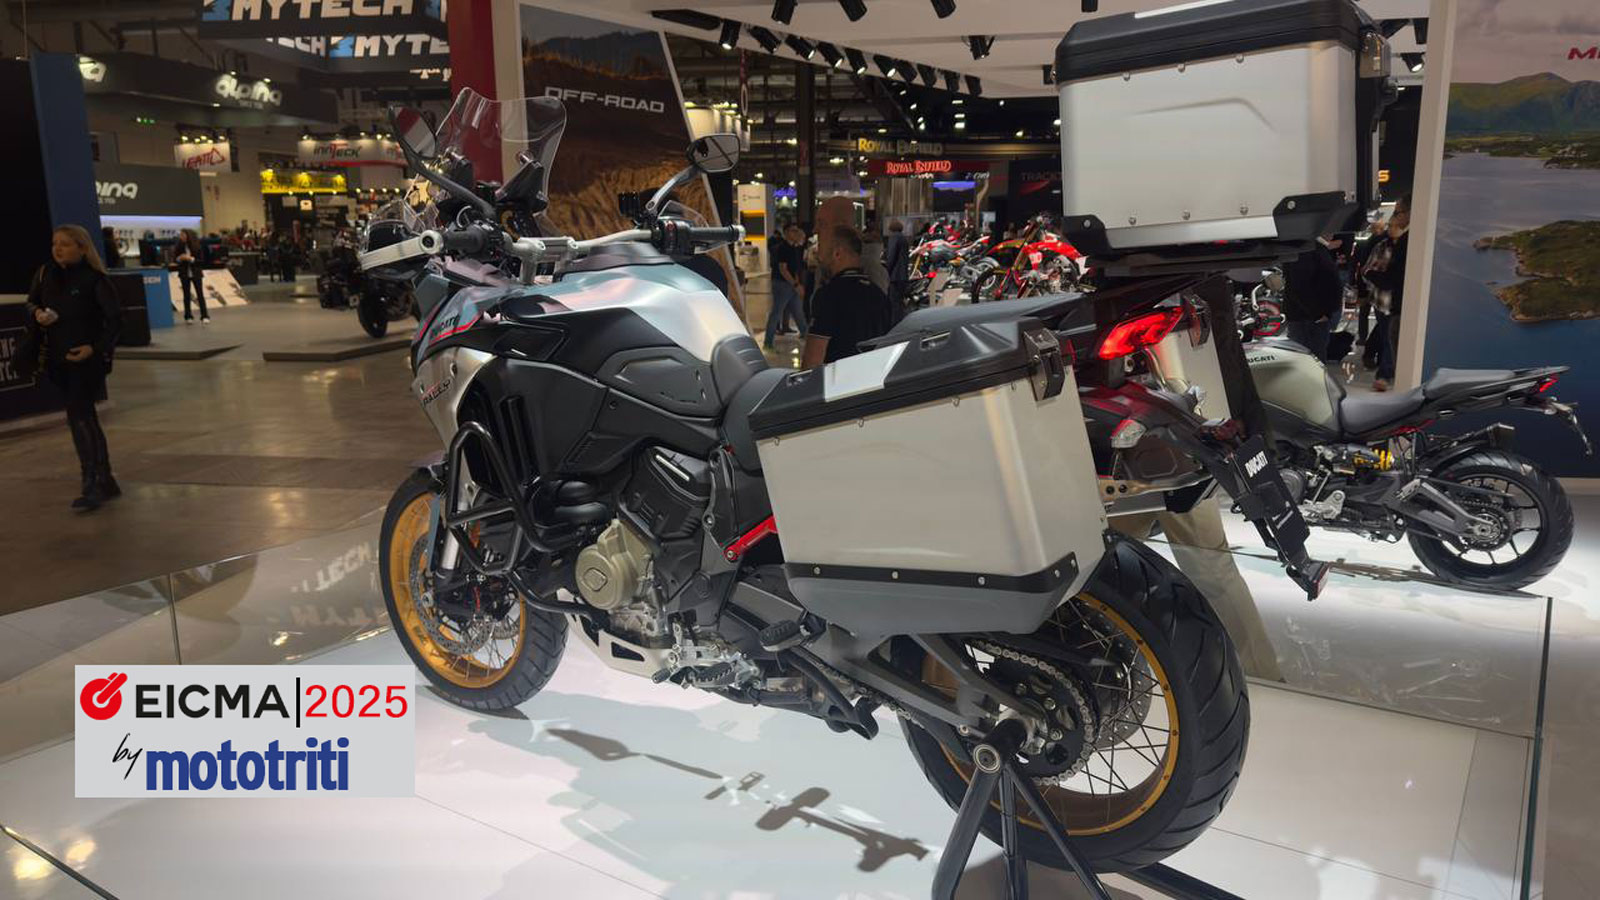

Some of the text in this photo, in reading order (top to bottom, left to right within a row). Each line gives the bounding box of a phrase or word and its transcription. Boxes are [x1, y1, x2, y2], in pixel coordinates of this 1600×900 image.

[231, 0, 414, 20] MYTECH
[544, 86, 665, 114] OFF-ROAD
[858, 137, 895, 153] ROYAL
[885, 160, 952, 175] ROYAL ENFIELD
[1244, 450, 1269, 478] DUCATI
